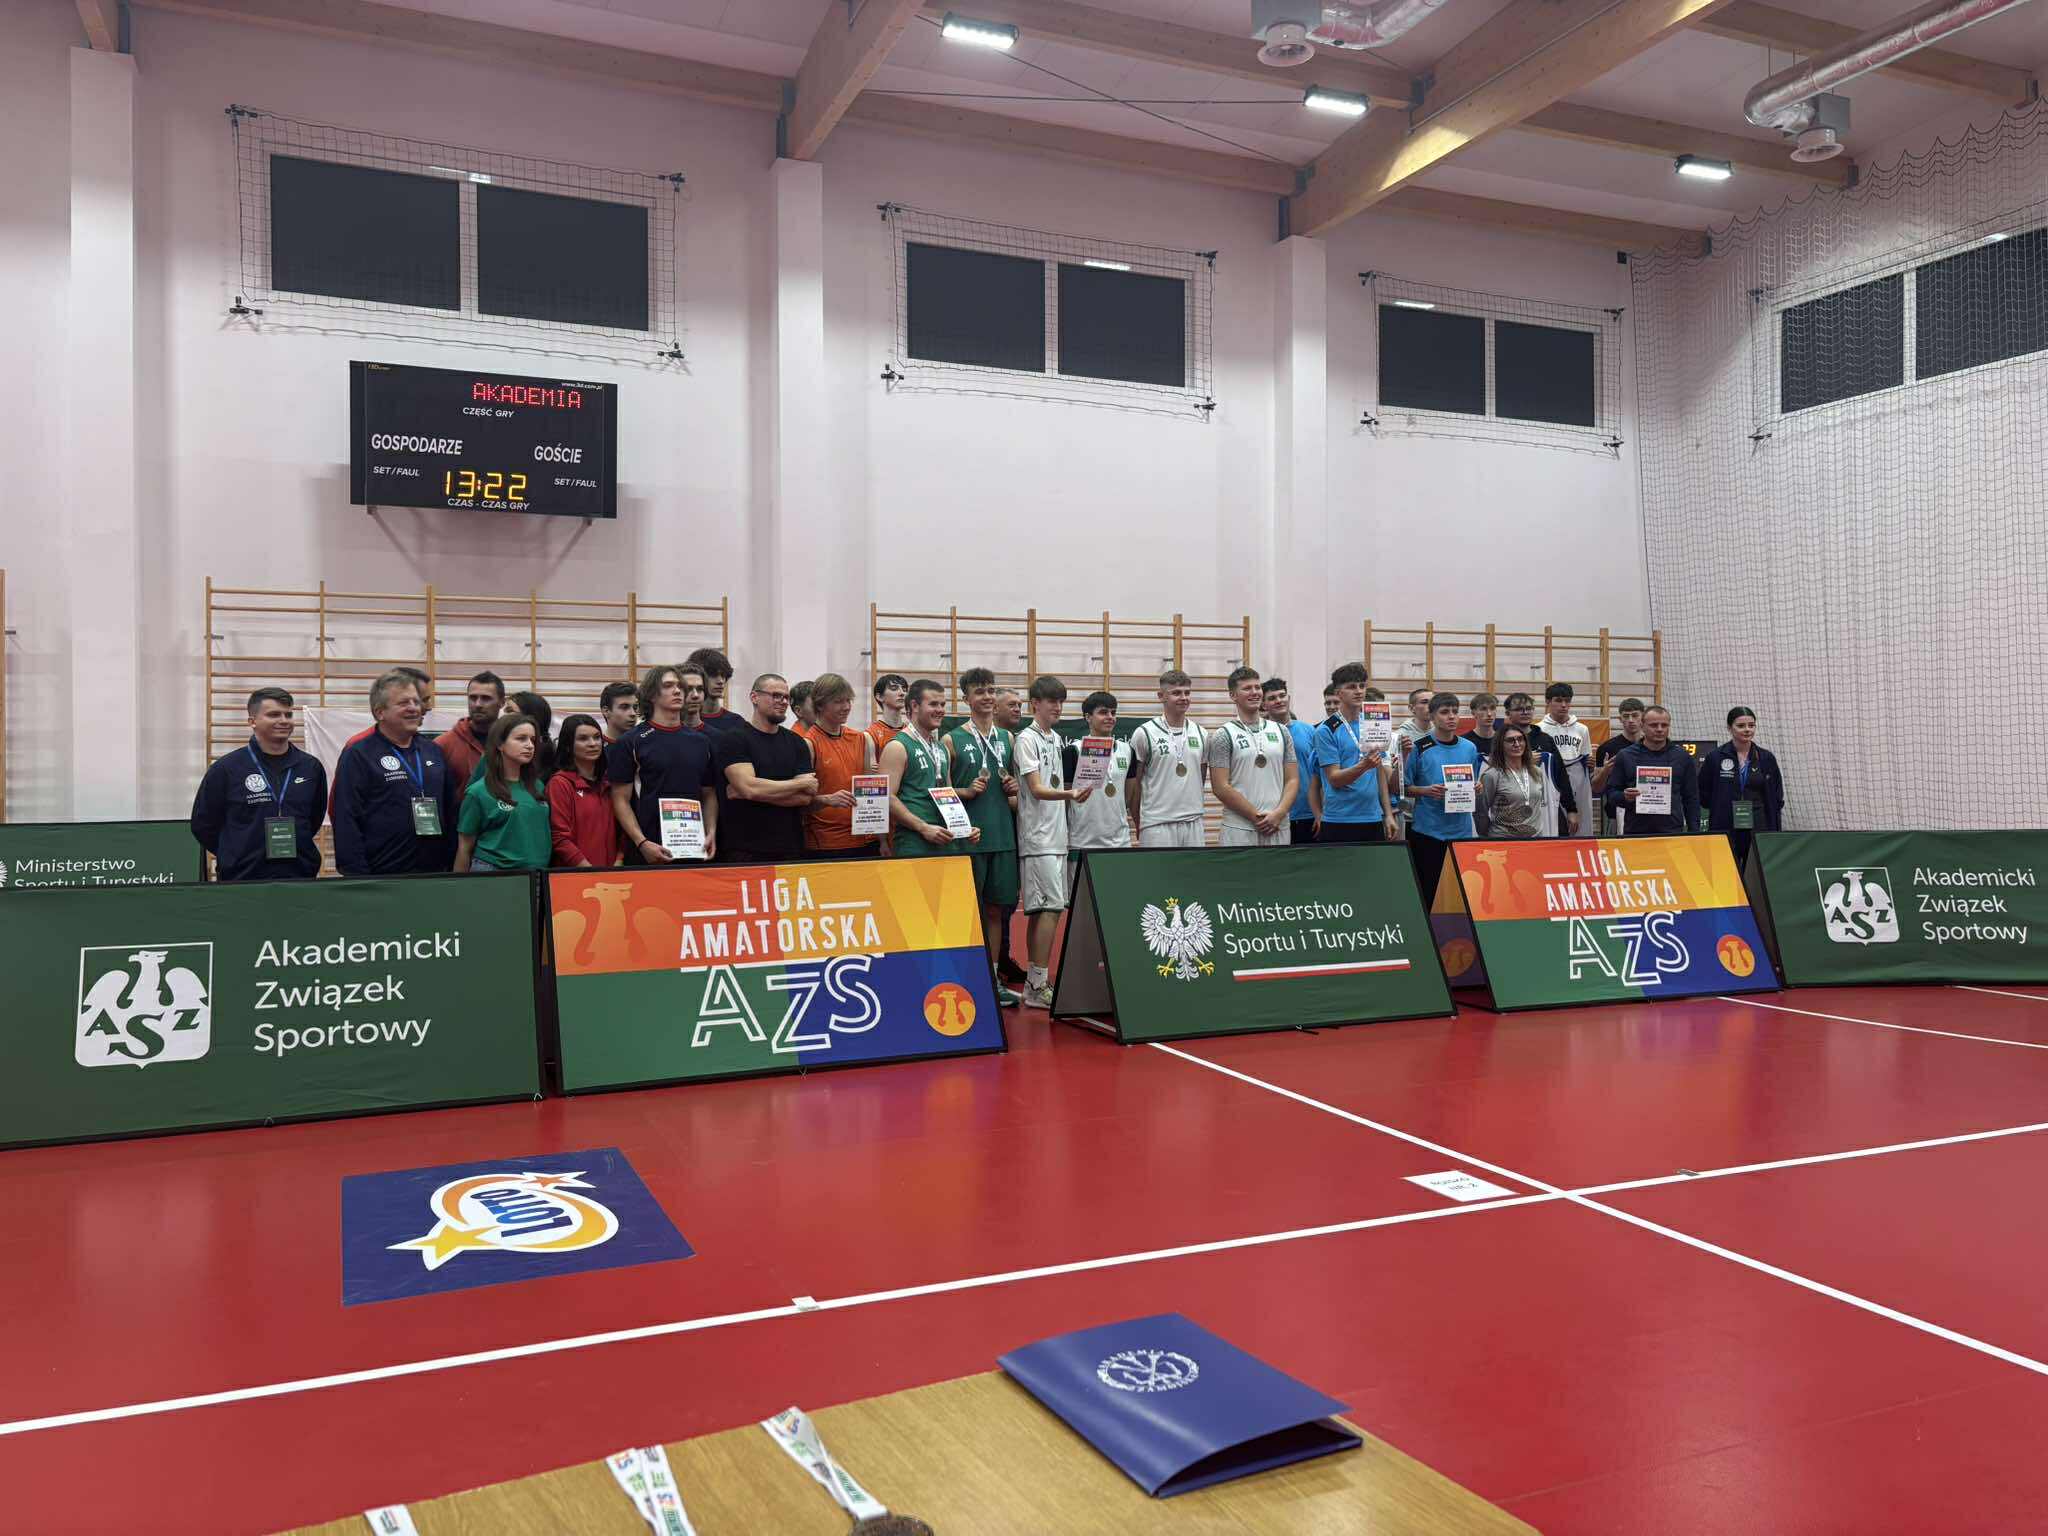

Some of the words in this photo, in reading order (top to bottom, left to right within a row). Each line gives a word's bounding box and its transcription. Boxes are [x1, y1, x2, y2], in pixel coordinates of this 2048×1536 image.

[473, 382, 580, 408] AKADEMIA
[463, 407, 493, 417] CZĘŚĆ
[495, 409, 514, 418] GRY
[371, 433, 463, 455] GOSPODARZE
[534, 443, 582, 464] GOŚCIE
[445, 470, 527, 500] 13:22
[447, 498, 473, 508] CZAS
[481, 499, 507, 509] CZAS
[509, 501, 530, 511] GRY
[1159, 745, 1170, 756] 12
[1238, 739, 1250, 750] 13
[16, 859, 135, 873] Ministerstwo
[1577, 848, 1628, 877] LIGA
[1913, 867, 2036, 887] Akademicki
[740, 877, 815, 914] LIGA
[1544, 878, 1679, 912] AMATORSKA
[1917, 894, 2008, 918] Związek
[1217, 900, 1353, 924] Ministerstwo
[680, 912, 882, 959] AMATORSKA
[1224, 932, 1296, 958] Sportu
[1299, 929, 1307, 950] i
[1309, 923, 1405, 951] Turystyki
[1922, 921, 2028, 945] Sportowy
[254, 931, 461, 968] Akademicki
[1569, 911, 1690, 987] AZS
[254, 973, 405, 1011] Związek
[690, 954, 882, 1054] AZS
[254, 1017, 432, 1057] Sportowy
[470, 1189, 573, 1238] LOTTO
